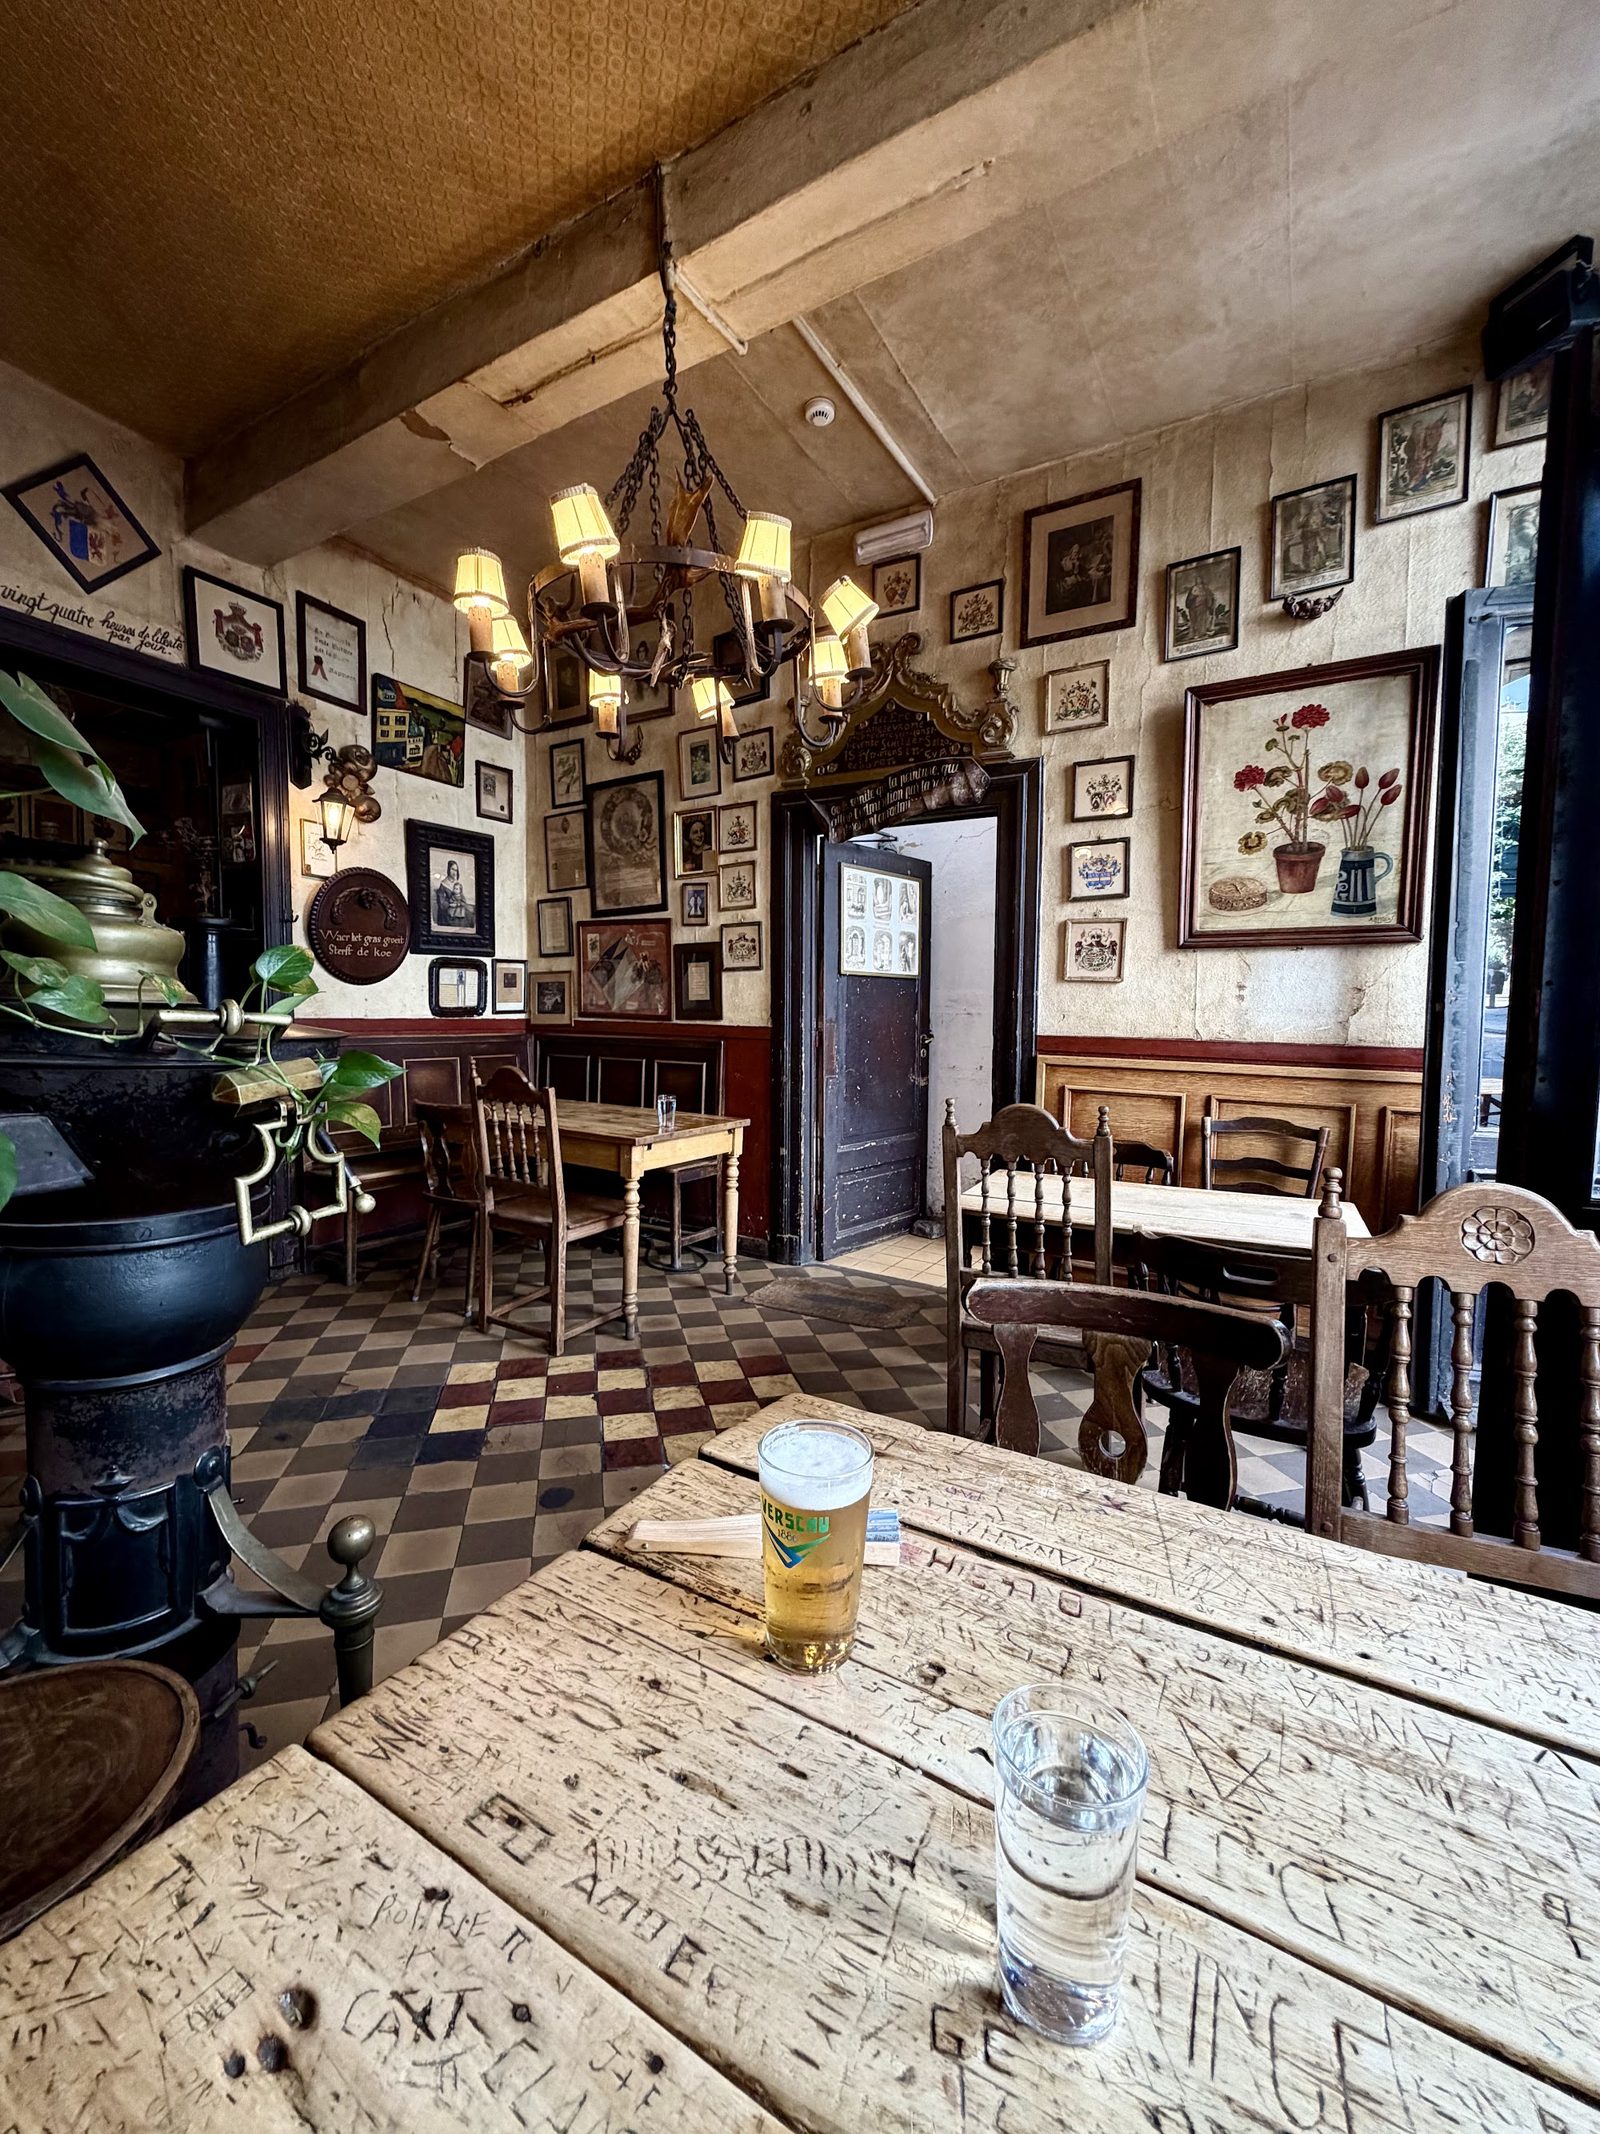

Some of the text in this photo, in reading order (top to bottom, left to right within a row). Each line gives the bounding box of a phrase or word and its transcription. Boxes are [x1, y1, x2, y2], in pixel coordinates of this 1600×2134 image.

[0, 584, 48, 616] vingt
[49, 601, 95, 629] quatre
[100, 611, 137, 637] heures
[137, 625, 150, 639] de
[107, 629, 132, 645] par
[320, 929, 405, 947] Waer het gras groeit
[328, 943, 392, 957] Sterft de koe
